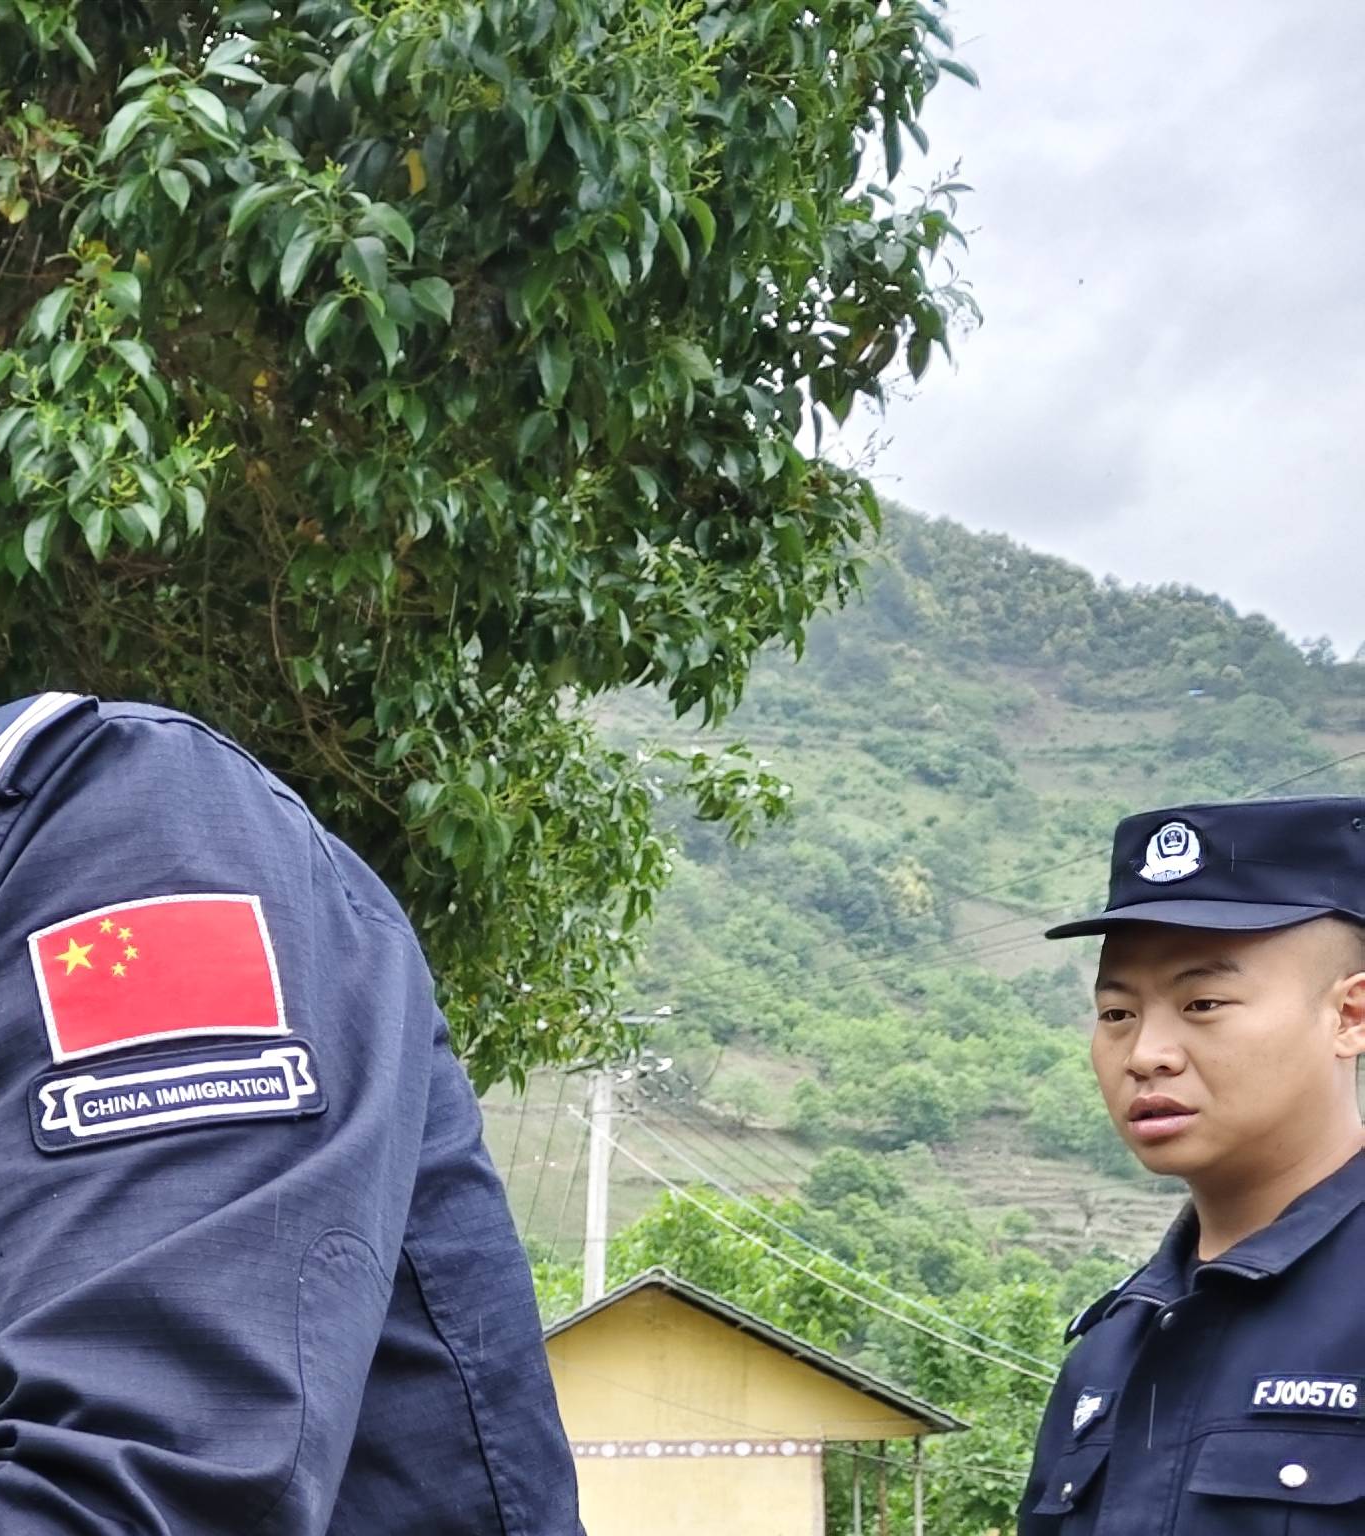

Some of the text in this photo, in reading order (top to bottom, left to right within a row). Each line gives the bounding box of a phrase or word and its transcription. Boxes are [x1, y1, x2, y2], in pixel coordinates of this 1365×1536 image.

[83, 1077, 283, 1118] CHINA IMMIGRATION
[1253, 1380, 1358, 1409] FJ00576
